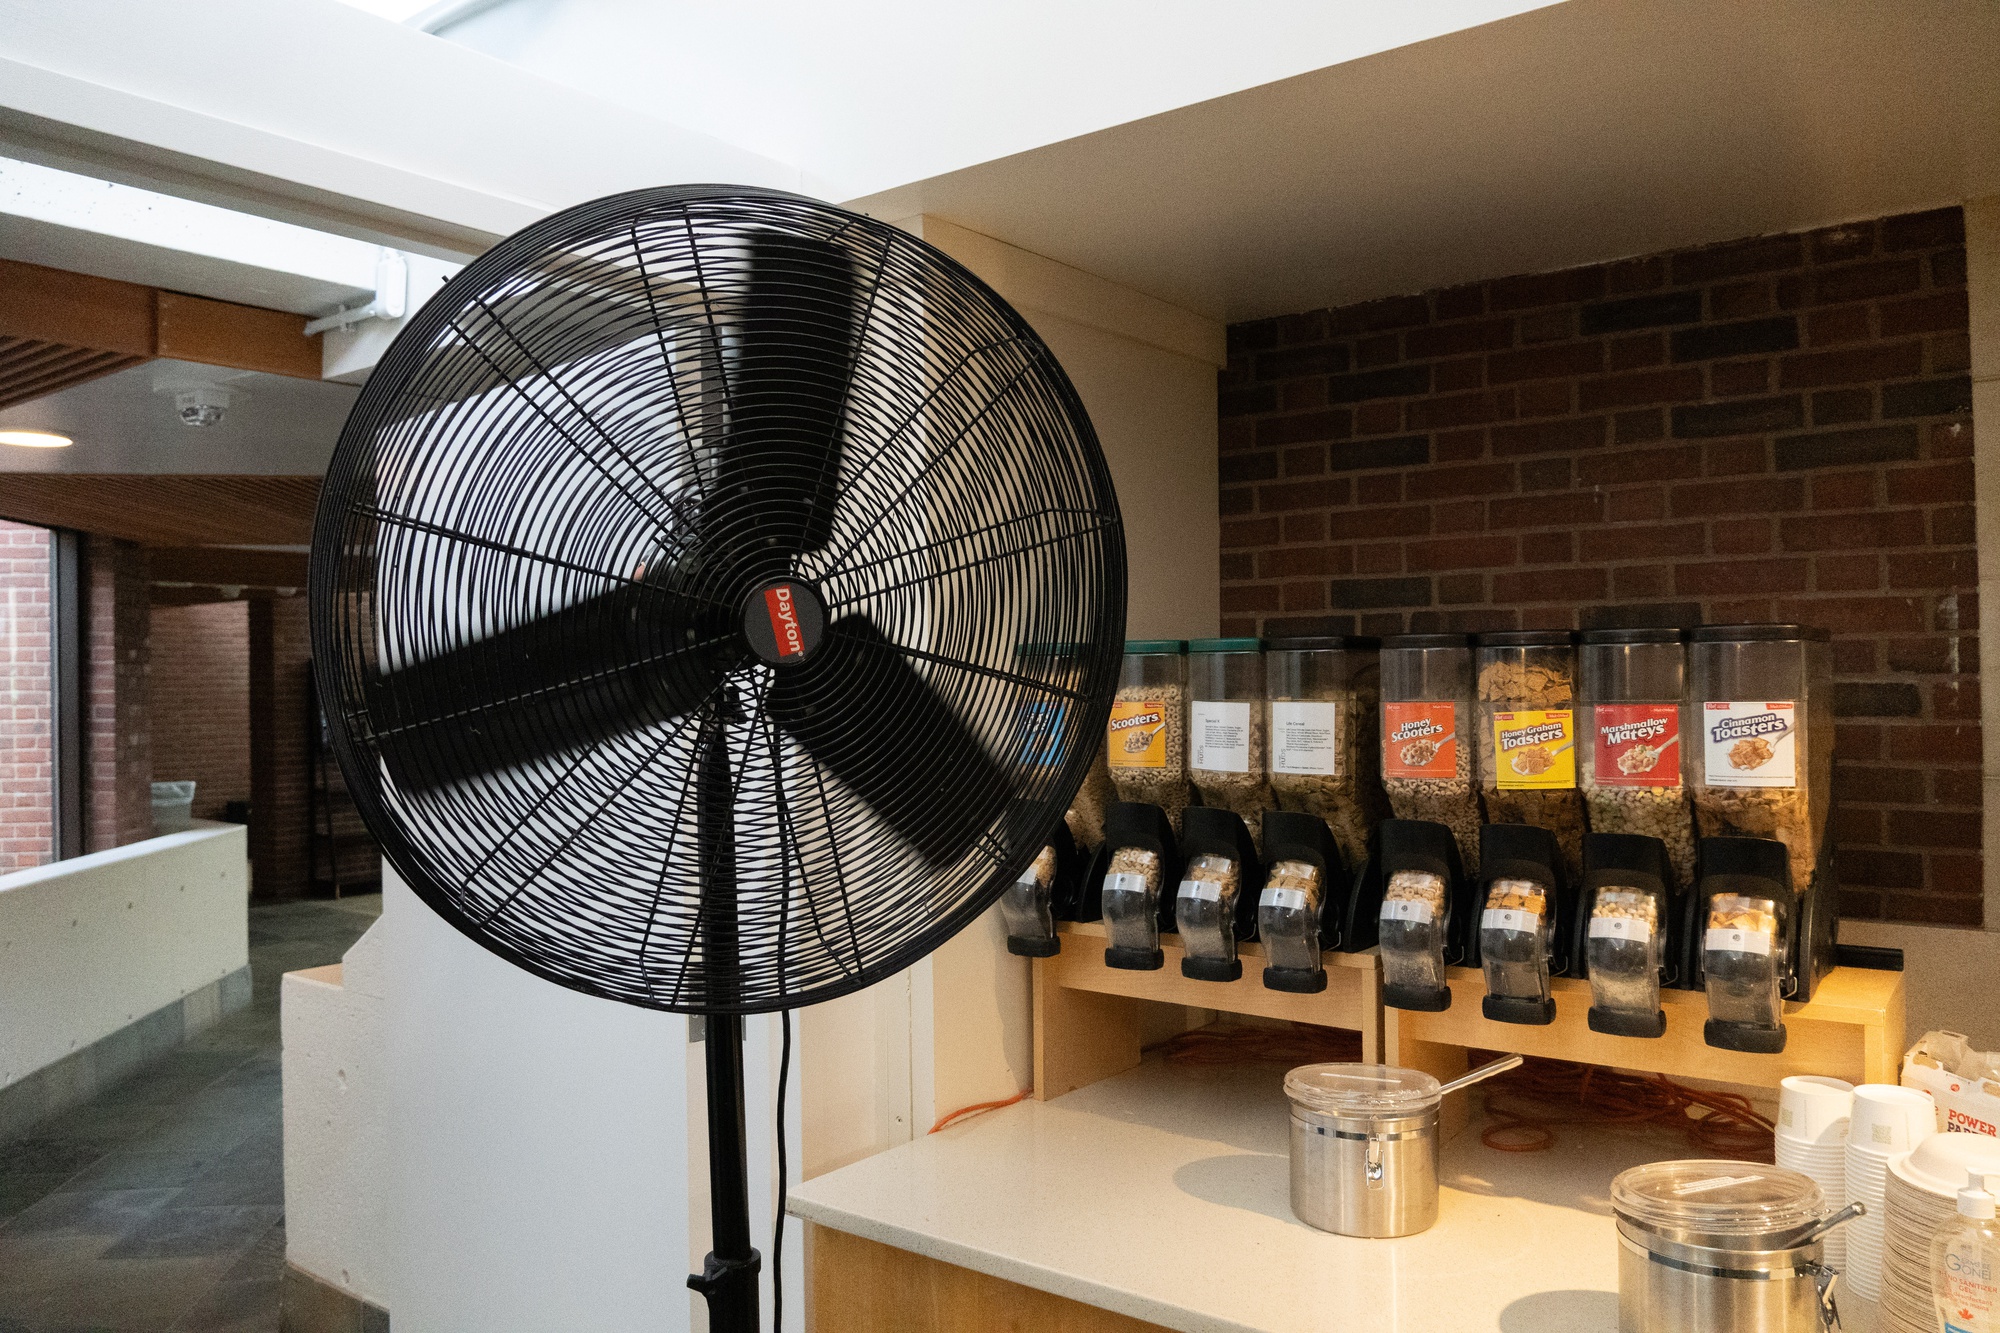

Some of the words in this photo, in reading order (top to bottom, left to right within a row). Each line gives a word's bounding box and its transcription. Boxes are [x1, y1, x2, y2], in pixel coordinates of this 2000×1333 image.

[776, 588, 801, 652] Dayton
[1111, 713, 1159, 731] Scooters
[1401, 718, 1431, 732] Honey
[1502, 729, 1526, 739] Honey
[1527, 723, 1562, 734] Graham
[1600, 718, 1668, 735] Marshmallow
[1713, 720, 1785, 741] Toasters
[1721, 714, 1775, 729] Cinnamon
[1391, 724, 1443, 743] Scooters
[1502, 729, 1563, 750] Toasters
[1607, 725, 1665, 745] Mateys
[1948, 1109, 1997, 1137] POWER
